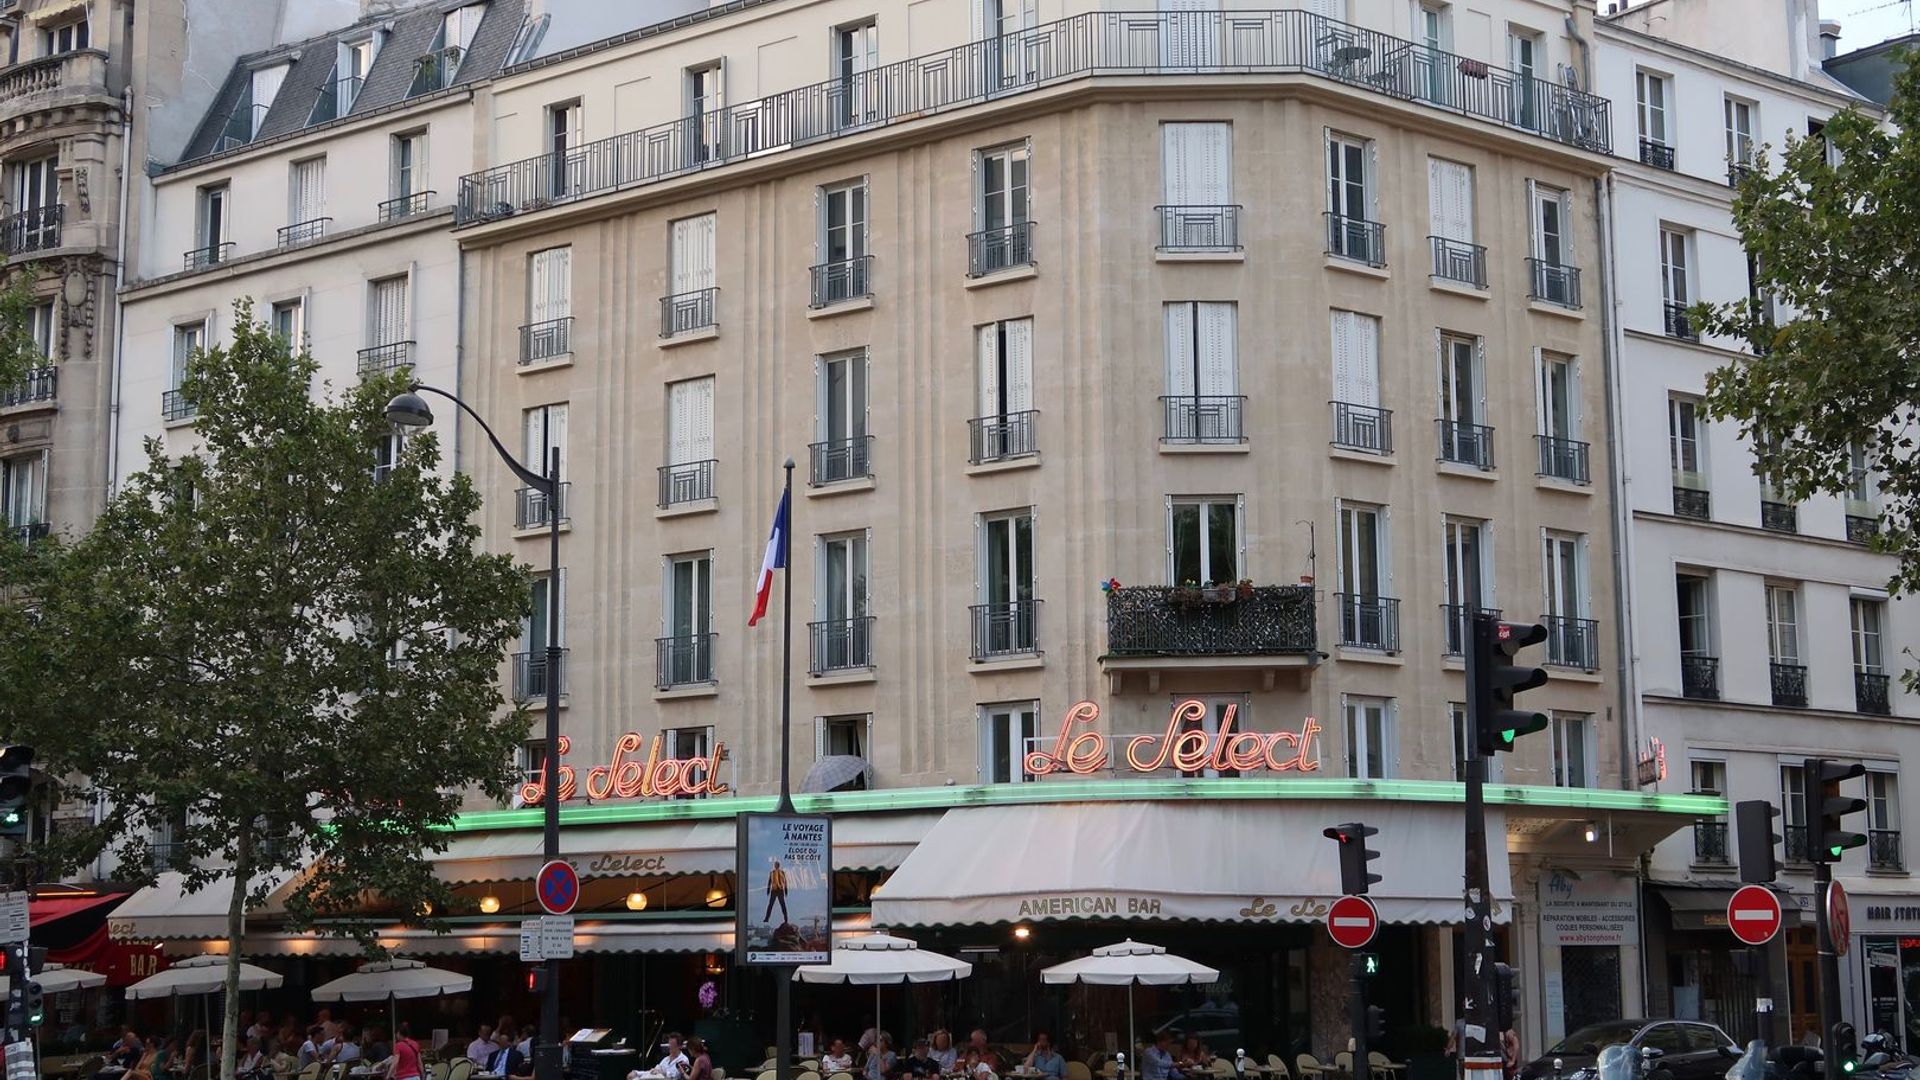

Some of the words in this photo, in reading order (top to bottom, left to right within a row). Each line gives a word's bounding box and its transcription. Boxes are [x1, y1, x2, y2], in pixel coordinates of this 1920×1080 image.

[1024, 700, 1108, 775] Le
[1126, 699, 1322, 773] Select
[586, 731, 728, 800] Select
[782, 823, 792, 831] LE
[793, 824, 824, 833] VOYAGE
[791, 833, 823, 841] NANTES
[589, 853, 666, 872] Select
[1018, 897, 1117, 916] AMERICAN
[1128, 897, 1162, 914] BAR
[1239, 897, 1278, 917] Le
[1867, 906, 1891, 920] HAIR
[129, 954, 157, 976] BAR
